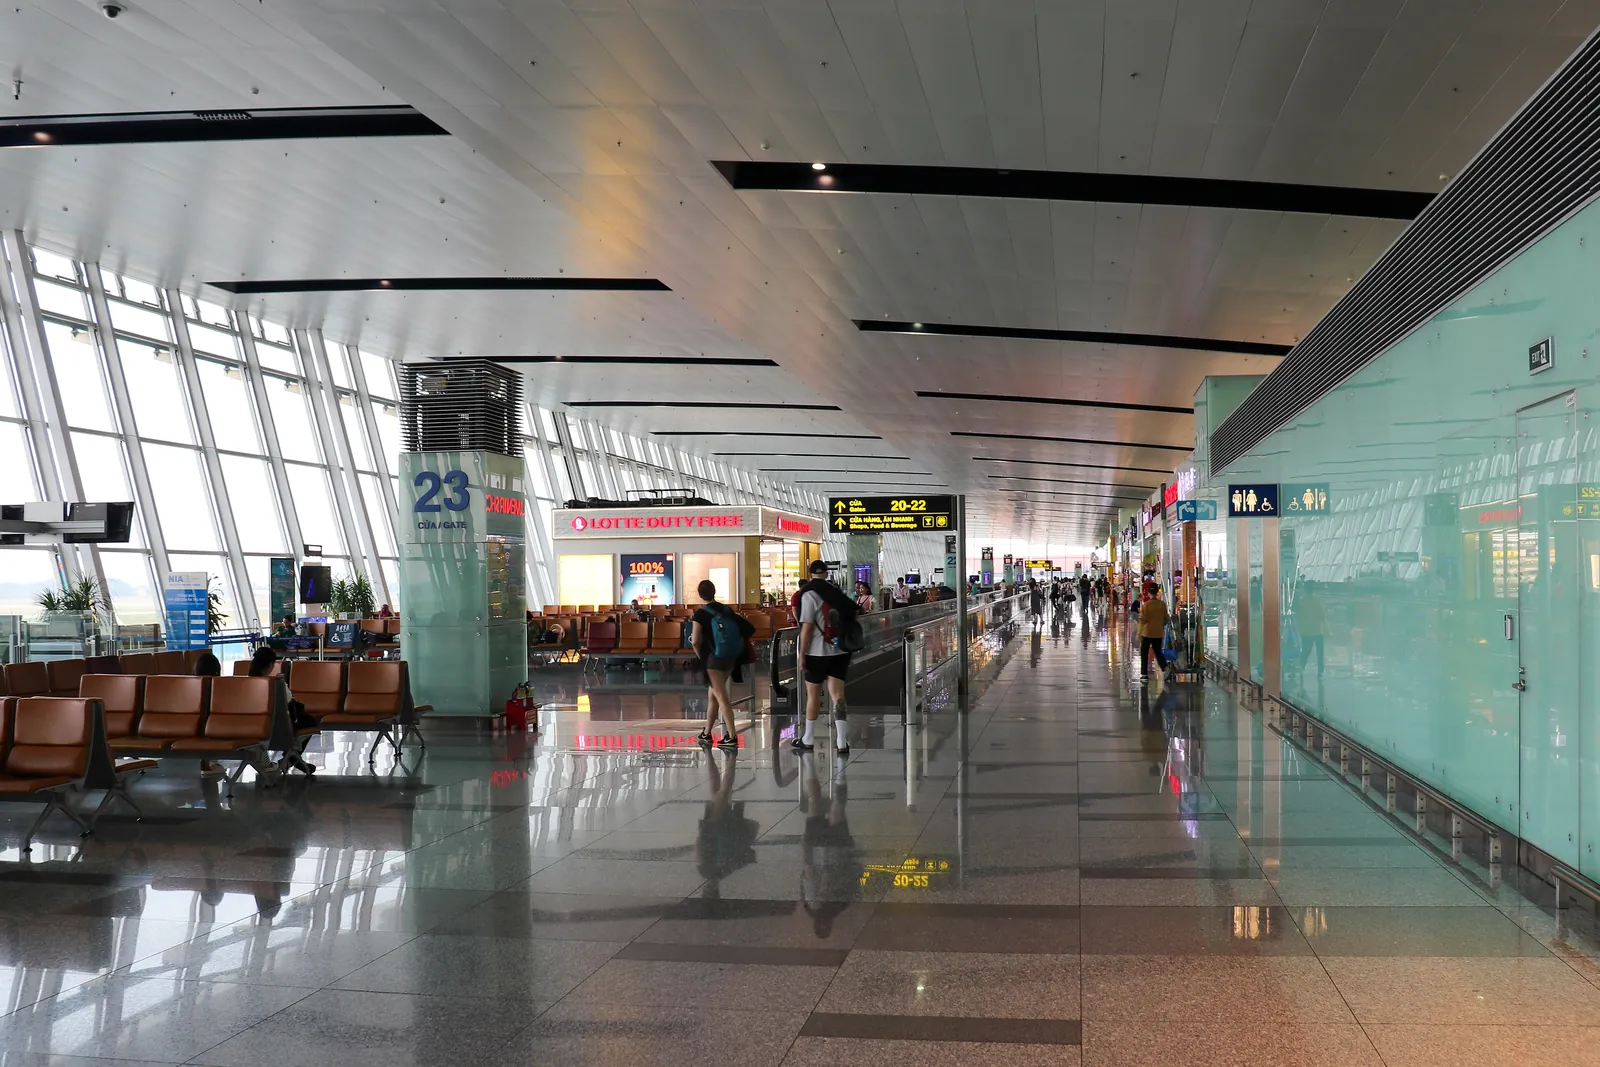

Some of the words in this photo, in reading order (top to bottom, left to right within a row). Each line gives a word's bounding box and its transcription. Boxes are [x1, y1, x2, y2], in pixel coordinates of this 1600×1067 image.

[1531, 350, 1540, 363] EXIT
[414, 470, 470, 512] 23
[891, 500, 926, 511] 20-22
[417, 520, 437, 529] CỬA
[443, 521, 467, 529] GATE
[590, 518, 643, 529] LOTTE
[647, 516, 695, 528] DUTY
[697, 515, 743, 527] FREE
[629, 561, 664, 574] 100%
